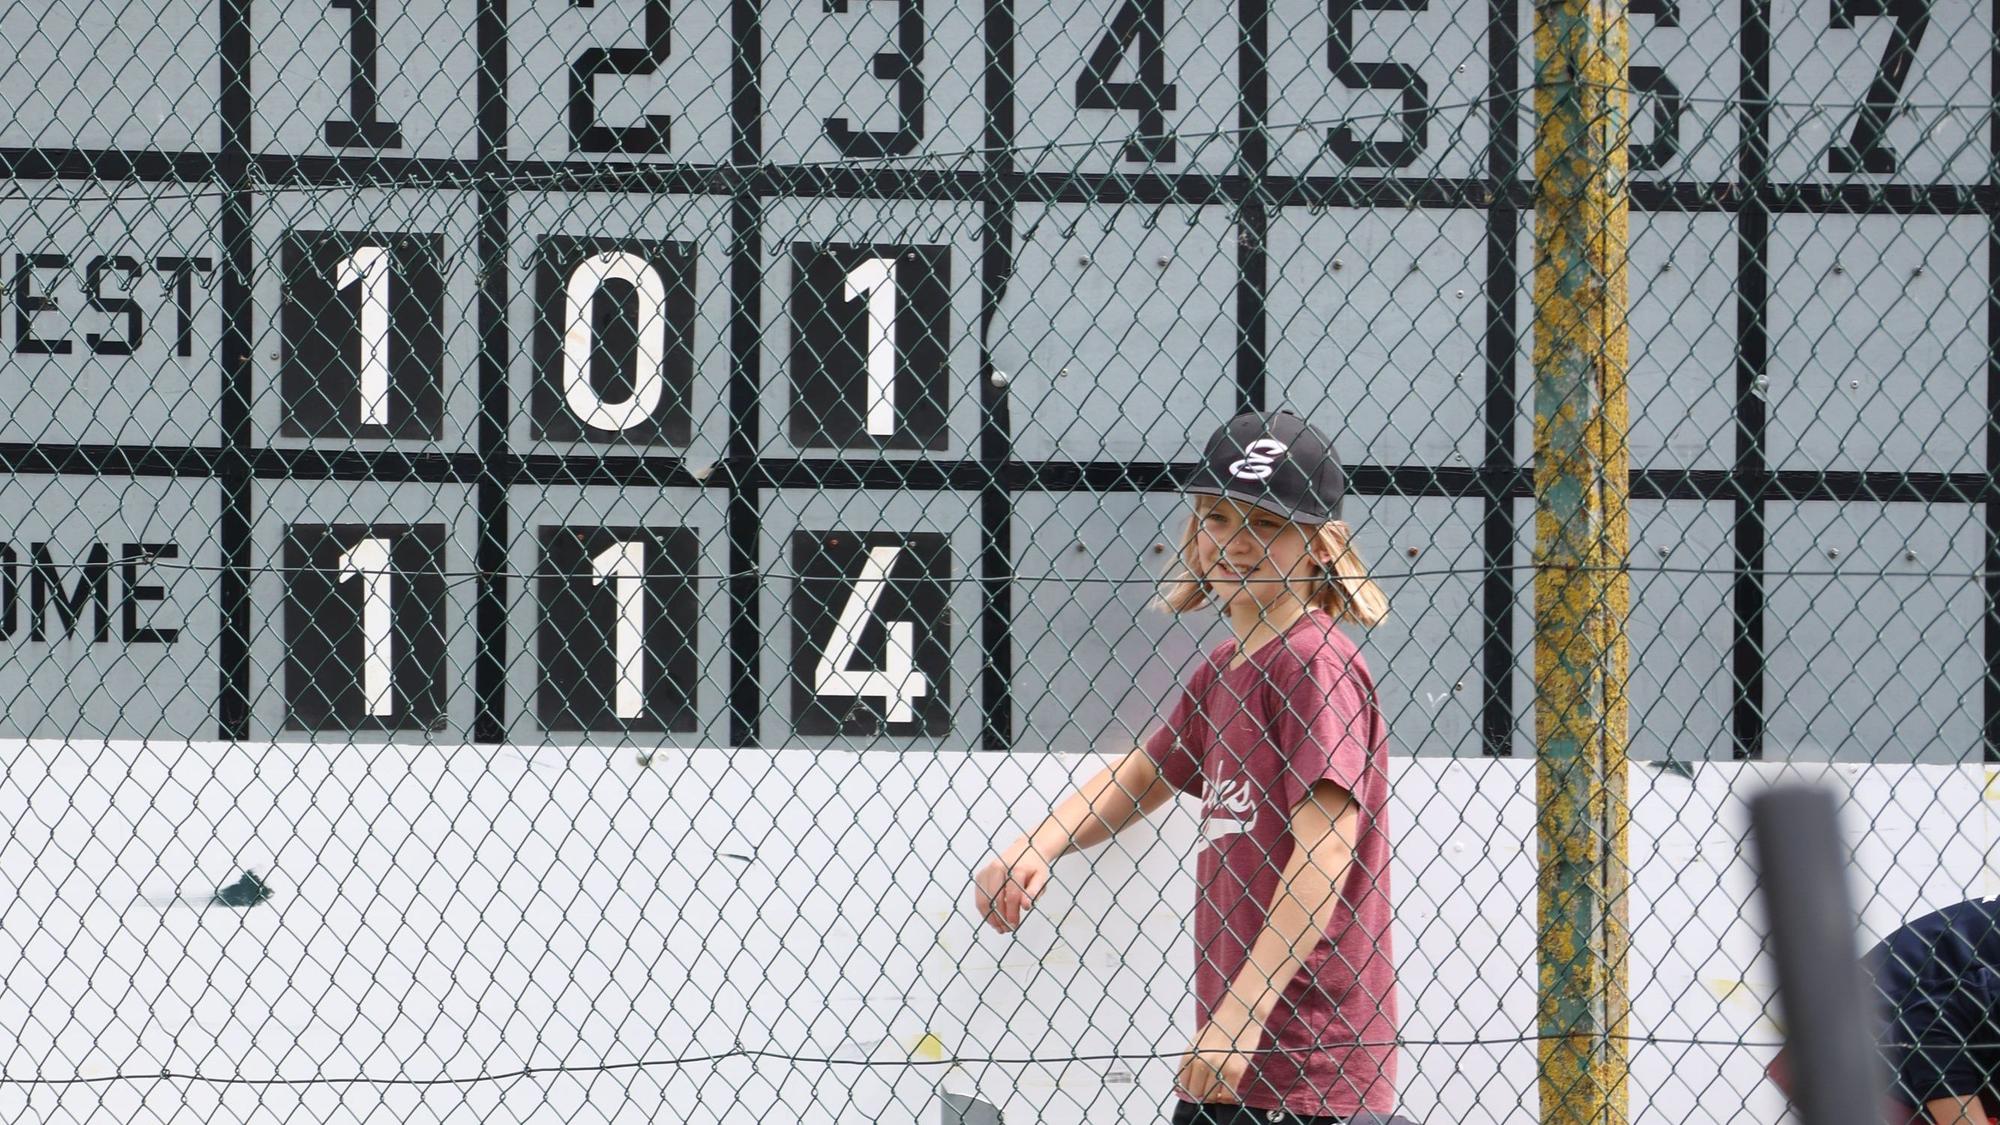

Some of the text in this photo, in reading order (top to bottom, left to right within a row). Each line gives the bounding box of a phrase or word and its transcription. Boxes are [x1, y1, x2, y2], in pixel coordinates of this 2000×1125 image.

[325, 0, 402, 148] 1
[569, 0, 671, 153] 2
[823, 0, 924, 158] 3
[1075, 0, 1177, 163] 4
[1327, 0, 1428, 168] 5
[1828, 0, 1935, 174] 7
[336, 246, 390, 424] 1
[562, 252, 666, 432] 0
[844, 257, 897, 436] 1
[338, 538, 392, 716] 1
[592, 541, 645, 718] 1
[814, 546, 927, 723] 4
